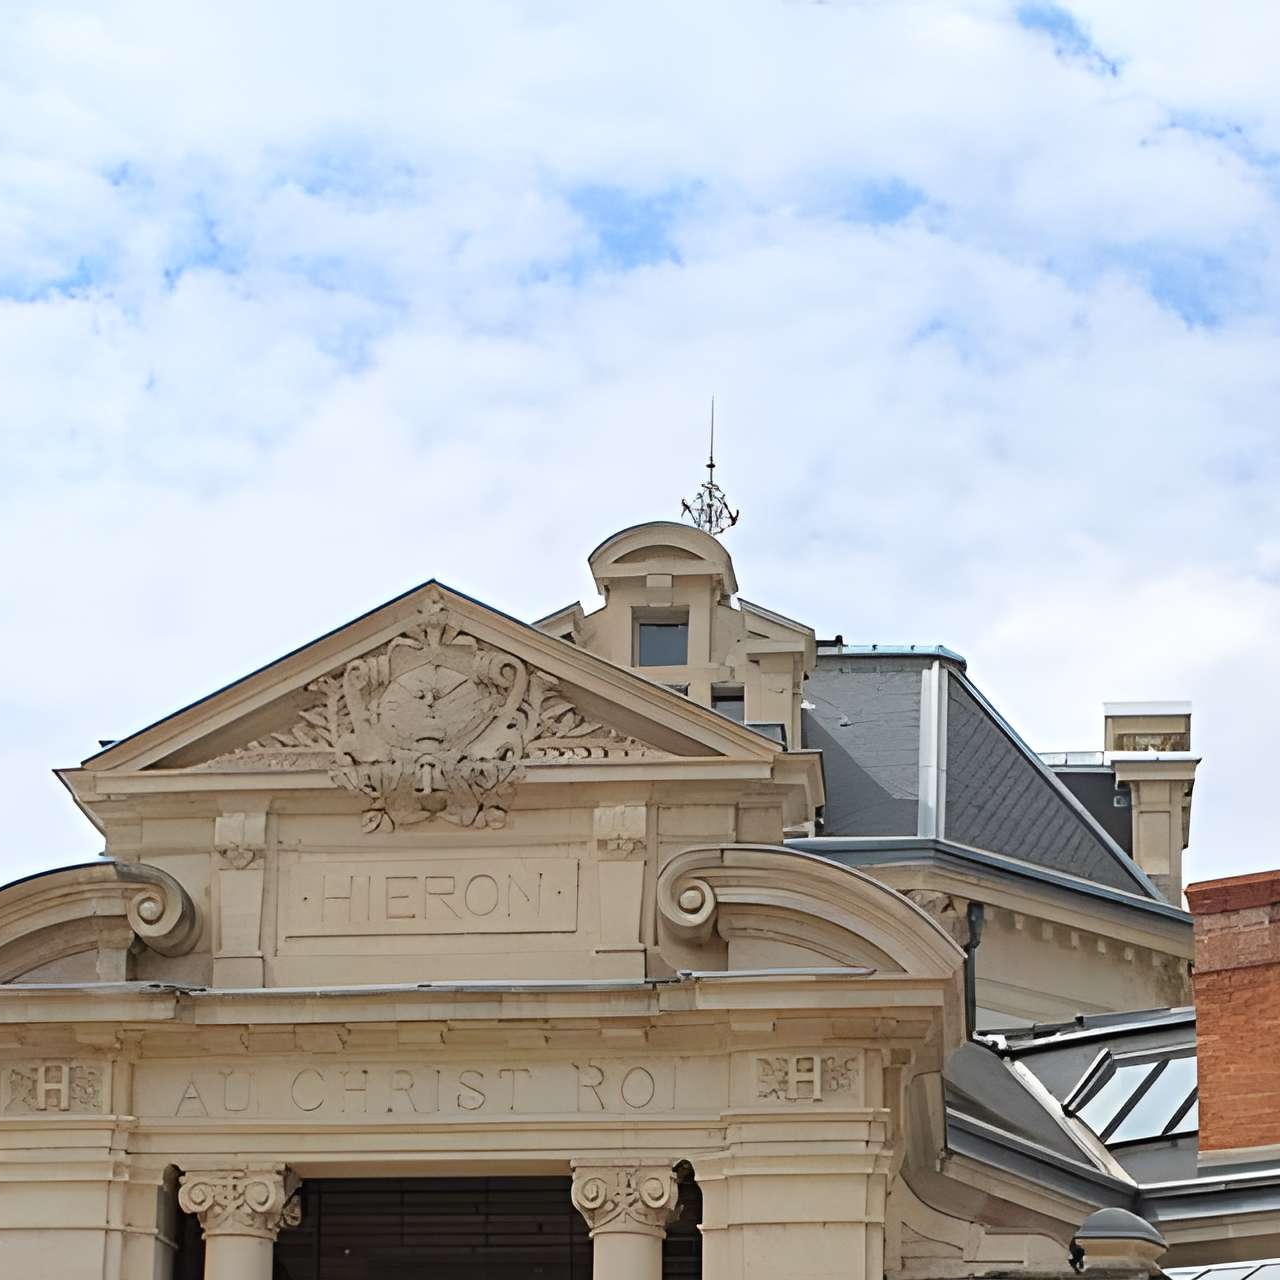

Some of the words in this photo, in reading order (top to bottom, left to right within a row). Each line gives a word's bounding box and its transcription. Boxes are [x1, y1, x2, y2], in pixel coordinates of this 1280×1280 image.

[320, 873, 544, 922] HIERON
[174, 1070, 257, 1117] AU
[291, 1068, 532, 1113] CHRIST
[571, 1063, 677, 1112] ROI
